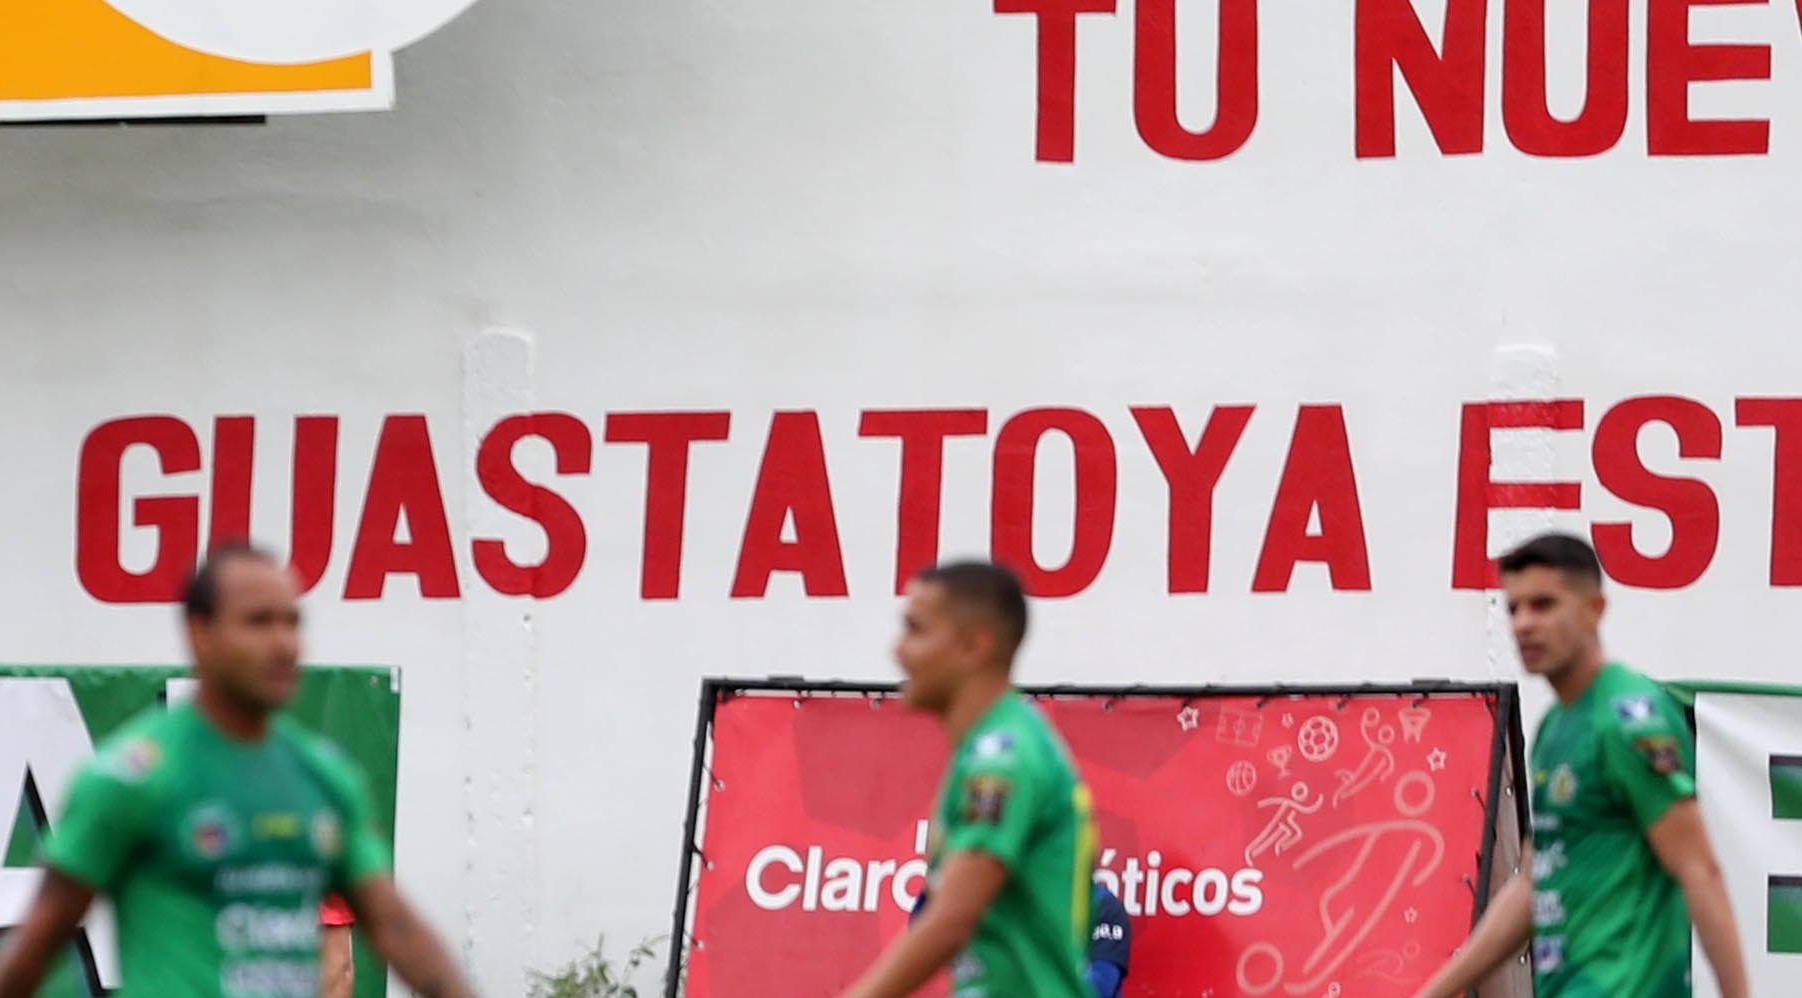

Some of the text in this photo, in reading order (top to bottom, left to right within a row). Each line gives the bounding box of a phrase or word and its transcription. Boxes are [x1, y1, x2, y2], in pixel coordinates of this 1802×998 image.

[993, 0, 1802, 162] TU NUE
[76, 405, 1372, 604] GUASTATOYA
